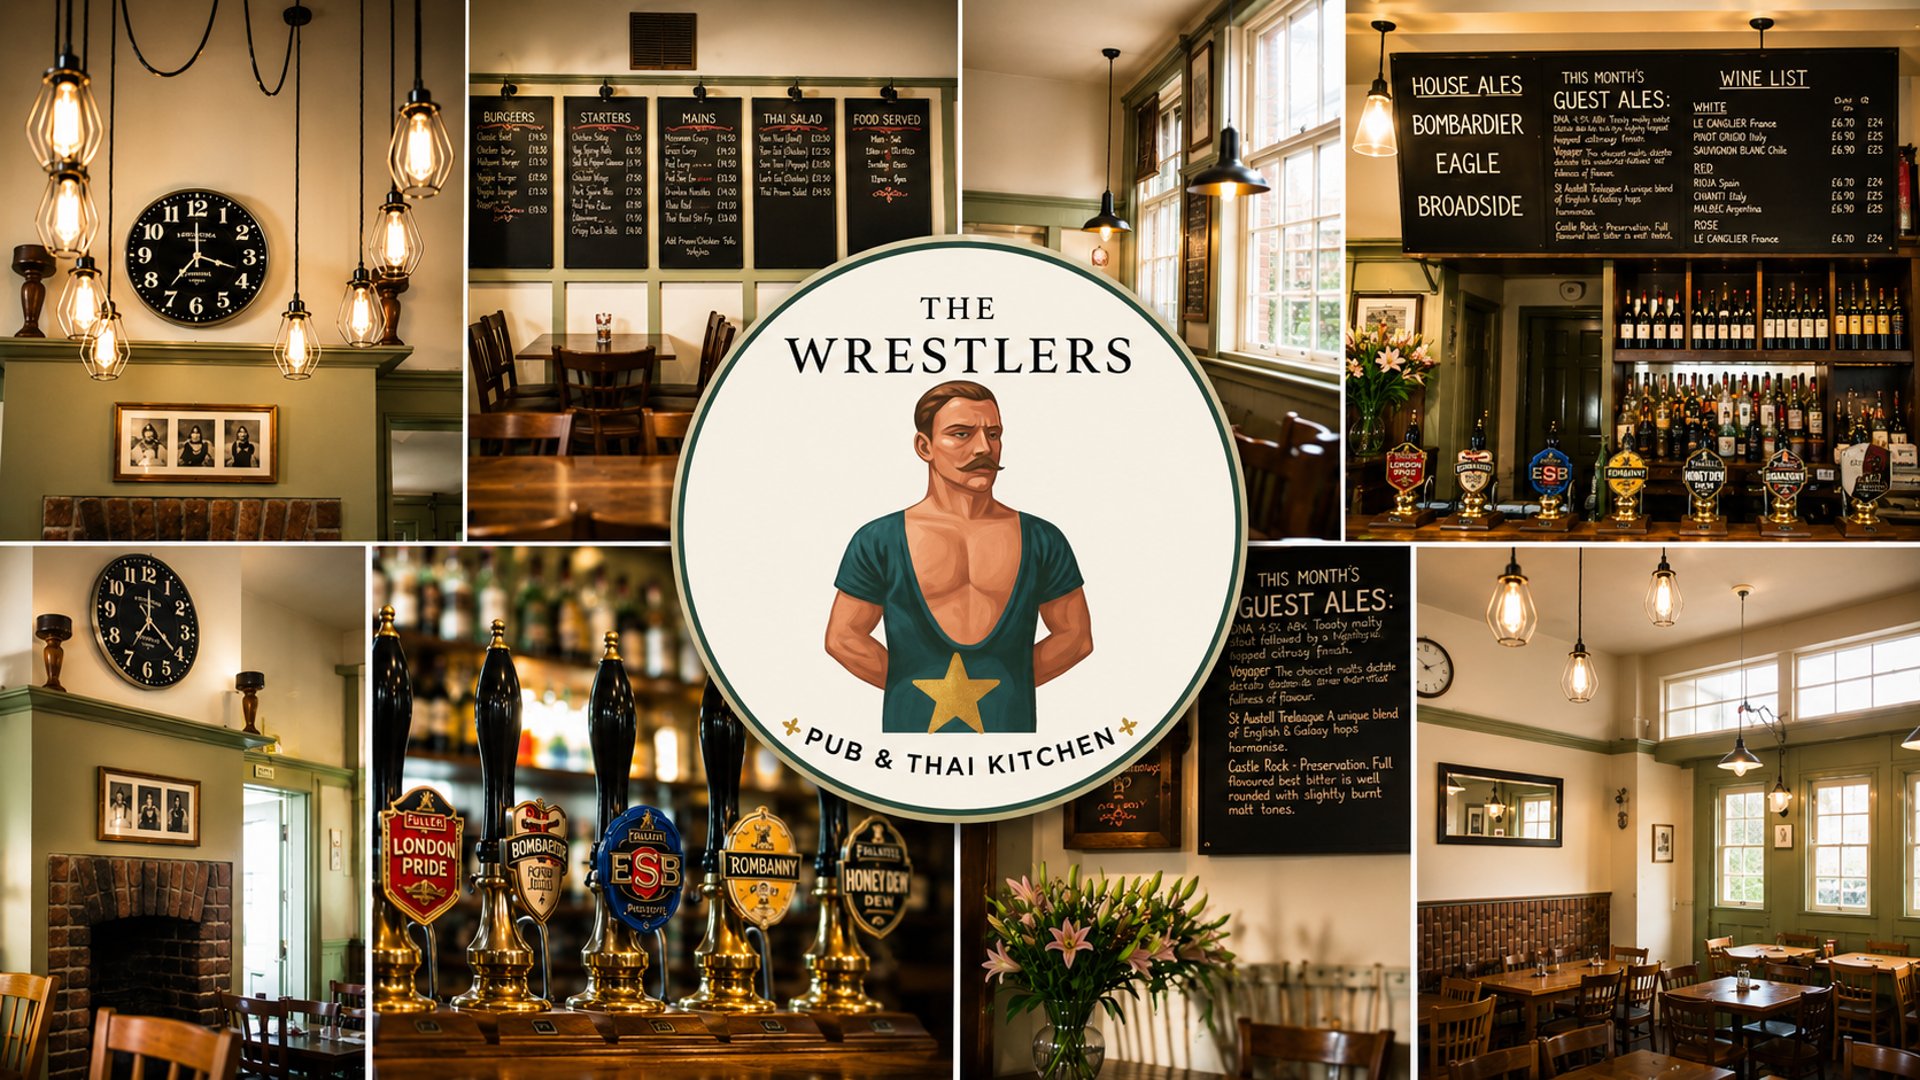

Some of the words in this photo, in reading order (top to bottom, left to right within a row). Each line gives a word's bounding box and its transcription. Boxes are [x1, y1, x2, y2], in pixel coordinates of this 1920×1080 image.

[1562, 71, 1589, 84] THIS
[1595, 69, 1645, 84] MONTH'S
[1720, 70, 1762, 86] WINE
[1771, 70, 1807, 86] LIST
[1412, 76, 1469, 95] HOUSE
[1478, 76, 1522, 94] ALES
[1554, 91, 1610, 109] GUEST
[1618, 90, 1670, 108] ALES:
[1694, 102, 1726, 111] WHITE
[581, 112, 631, 123] STARTERS
[682, 113, 716, 124] MAINS
[764, 113, 785, 124] THAI
[791, 113, 822, 124] SALAD
[854, 114, 879, 125] FOOD
[883, 114, 920, 125] SERVED
[1413, 114, 1523, 135] BOMBARDIER
[1694, 119, 1703, 128] LE
[1750, 119, 1776, 127] France
[1768, 145, 1787, 154] Chile
[1436, 153, 1500, 174] EAGLE
[1694, 179, 1716, 187] RIOJA
[1719, 179, 1739, 189] Spain
[163, 206, 180, 223] 11
[187, 200, 207, 217] 12
[1418, 196, 1523, 217] BROADSIDE
[219, 207, 227, 224] 1
[143, 223, 164, 240] 10
[236, 225, 249, 240] 2
[1695, 220, 1718, 230] ROSE
[1694, 234, 1703, 243] LE
[1751, 234, 1779, 243] France
[138, 247, 152, 264] 9
[243, 249, 256, 265] 3
[144, 272, 158, 288] 8
[235, 273, 249, 289] 4
[164, 291, 178, 307] 7
[189, 297, 203, 315] 6
[217, 292, 230, 308] 5
[1533, 466, 1568, 481] ESB
[125, 567, 136, 584] 11
[141, 566, 156, 584] 12
[1258, 572, 1289, 587] THIS
[1298, 567, 1360, 585] MONTH'S
[109, 579, 124, 596] 10
[165, 581, 170, 595] 1
[105, 601, 116, 618] 9
[176, 600, 184, 616] 2
[1239, 592, 1314, 619] GUEST
[1324, 588, 1393, 614] ALES:
[109, 627, 120, 644] 8
[181, 625, 190, 640] 3
[1261, 633, 1301, 645] followed
[125, 649, 134, 666] 7
[174, 646, 184, 661] 4
[142, 661, 152, 678] 6
[162, 660, 171, 675] 5
[1230, 665, 1271, 681] Voyager
[1275, 666, 1292, 677] The
[1229, 712, 1240, 724] St
[1243, 711, 1274, 724] Austell
[1327, 710, 1334, 721] A
[1338, 711, 1369, 723] unique
[1373, 707, 1399, 719] blend
[1229, 725, 1239, 739] of
[1244, 725, 1280, 741] English
[1284, 725, 1291, 736] &
[1333, 723, 1358, 737] hops
[1229, 741, 1287, 753] harmonise.
[1229, 759, 1259, 773] Castle
[1264, 758, 1289, 772] Rock
[1300, 757, 1369, 771] Preservation.
[1373, 756, 1393, 769] Full
[1229, 775, 1274, 787] flavoured
[1279, 775, 1300, 786] best
[1307, 773, 1336, 785] bitter
[1342, 773, 1350, 785] is
[1357, 772, 1380, 784] well
[1229, 790, 1270, 801] rounded
[1276, 789, 1298, 801] with
[1352, 787, 1382, 799] burnt
[1261, 803, 1295, 815] tones.
[394, 837, 455, 859] LONDON
[402, 858, 448, 877] PRIDE
[610, 853, 680, 888] ESB
[729, 856, 797, 876] ROMBANNY
[846, 869, 885, 892] HONEY
[886, 870, 909, 893] DEW
[865, 896, 894, 908] DEW
